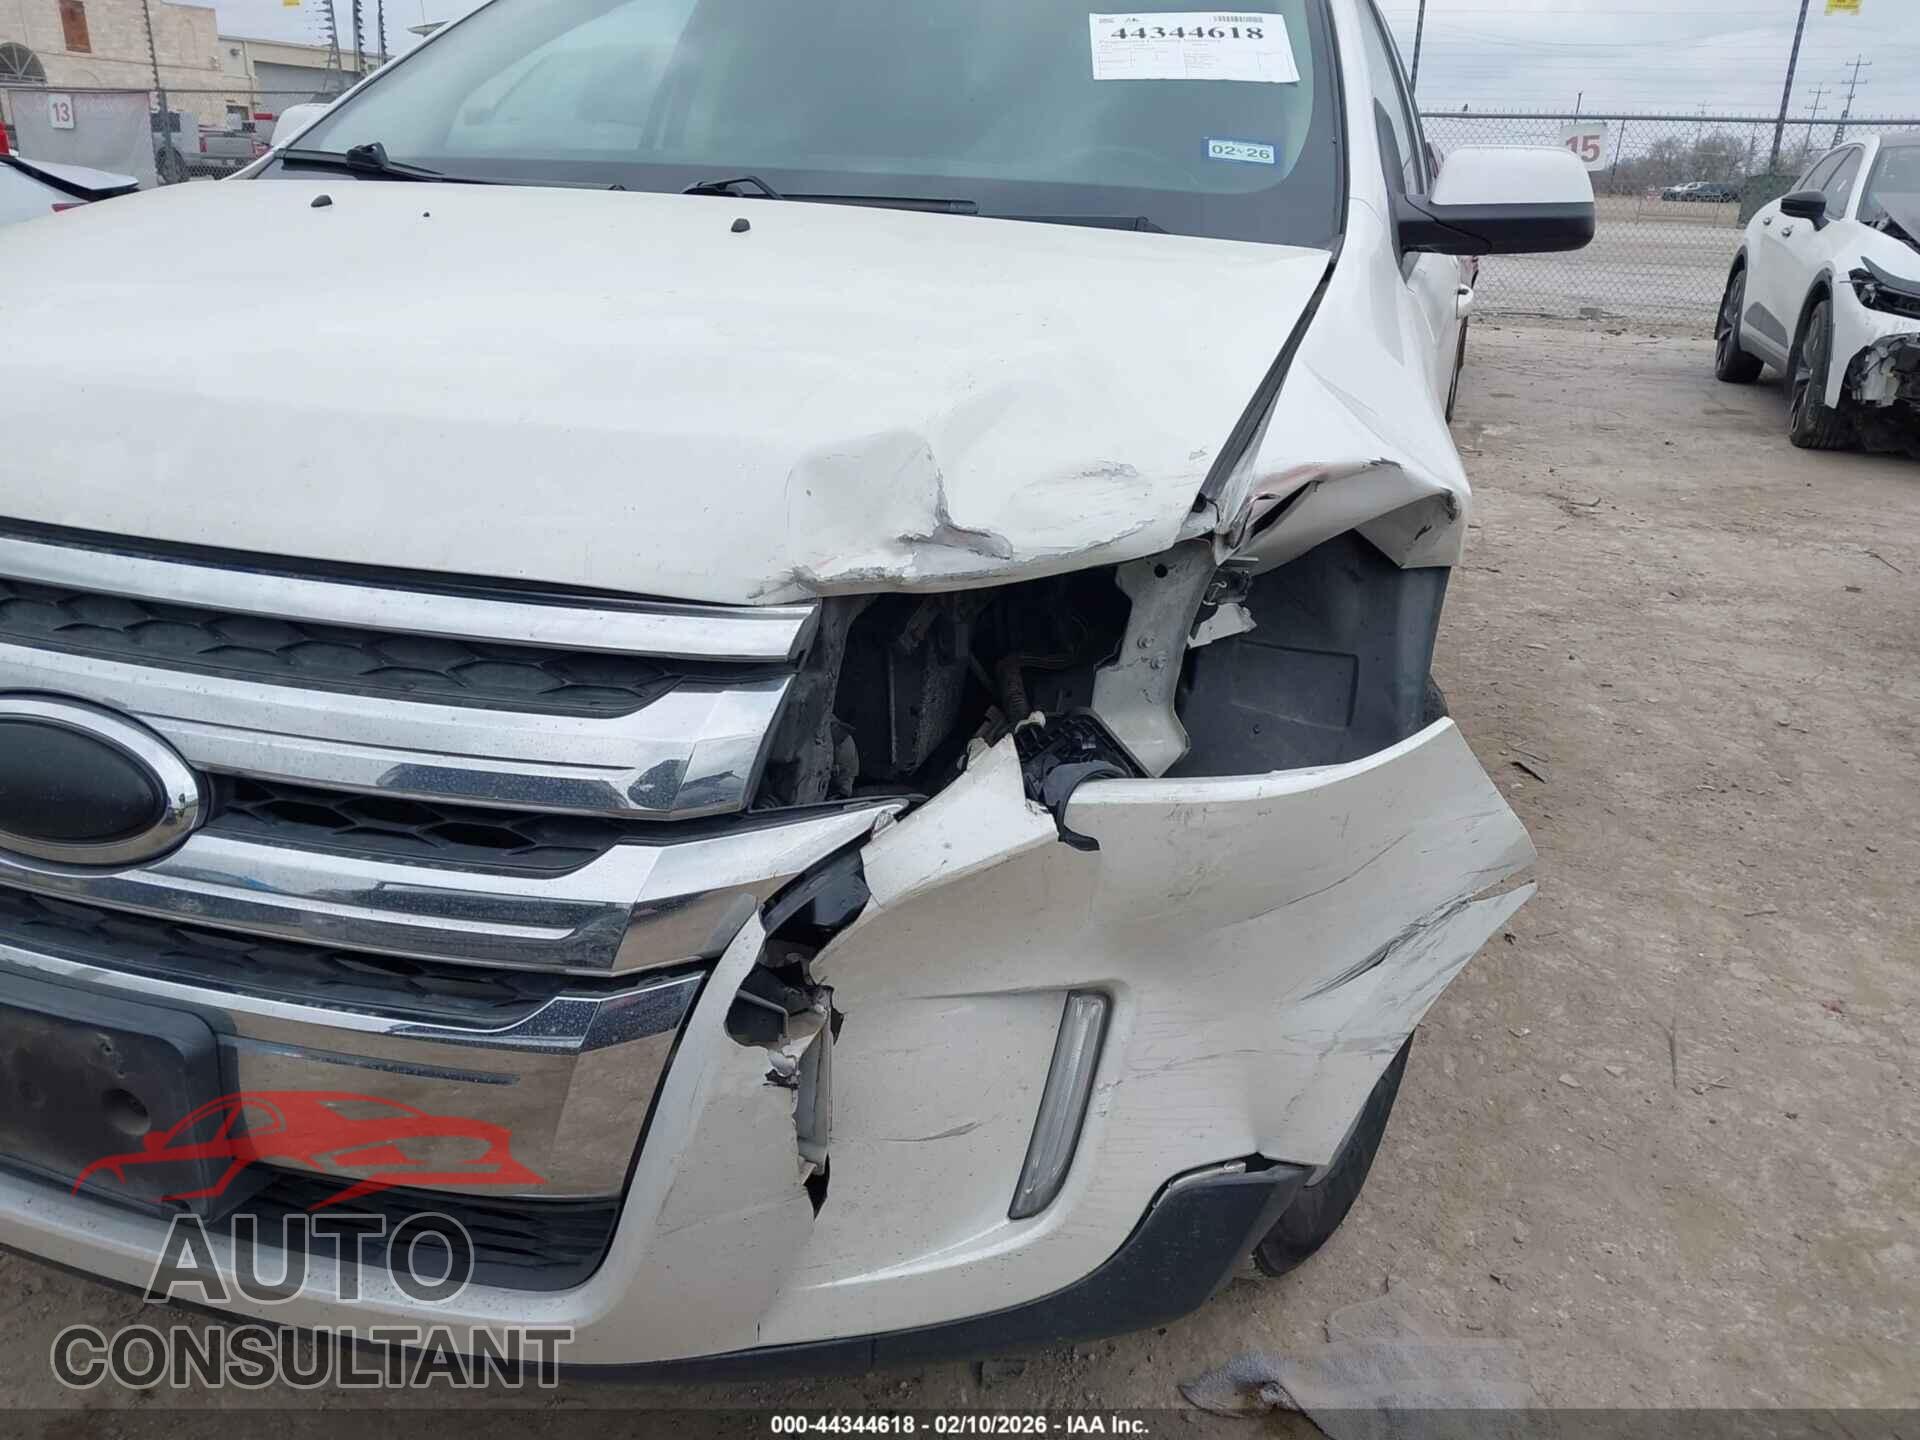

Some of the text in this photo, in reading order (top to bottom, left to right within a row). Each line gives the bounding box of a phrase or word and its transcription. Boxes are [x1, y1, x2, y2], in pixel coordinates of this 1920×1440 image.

[1111, 26, 1264, 40] 44344618
[52, 102, 70, 122] 13
[1566, 134, 1600, 163] 15
